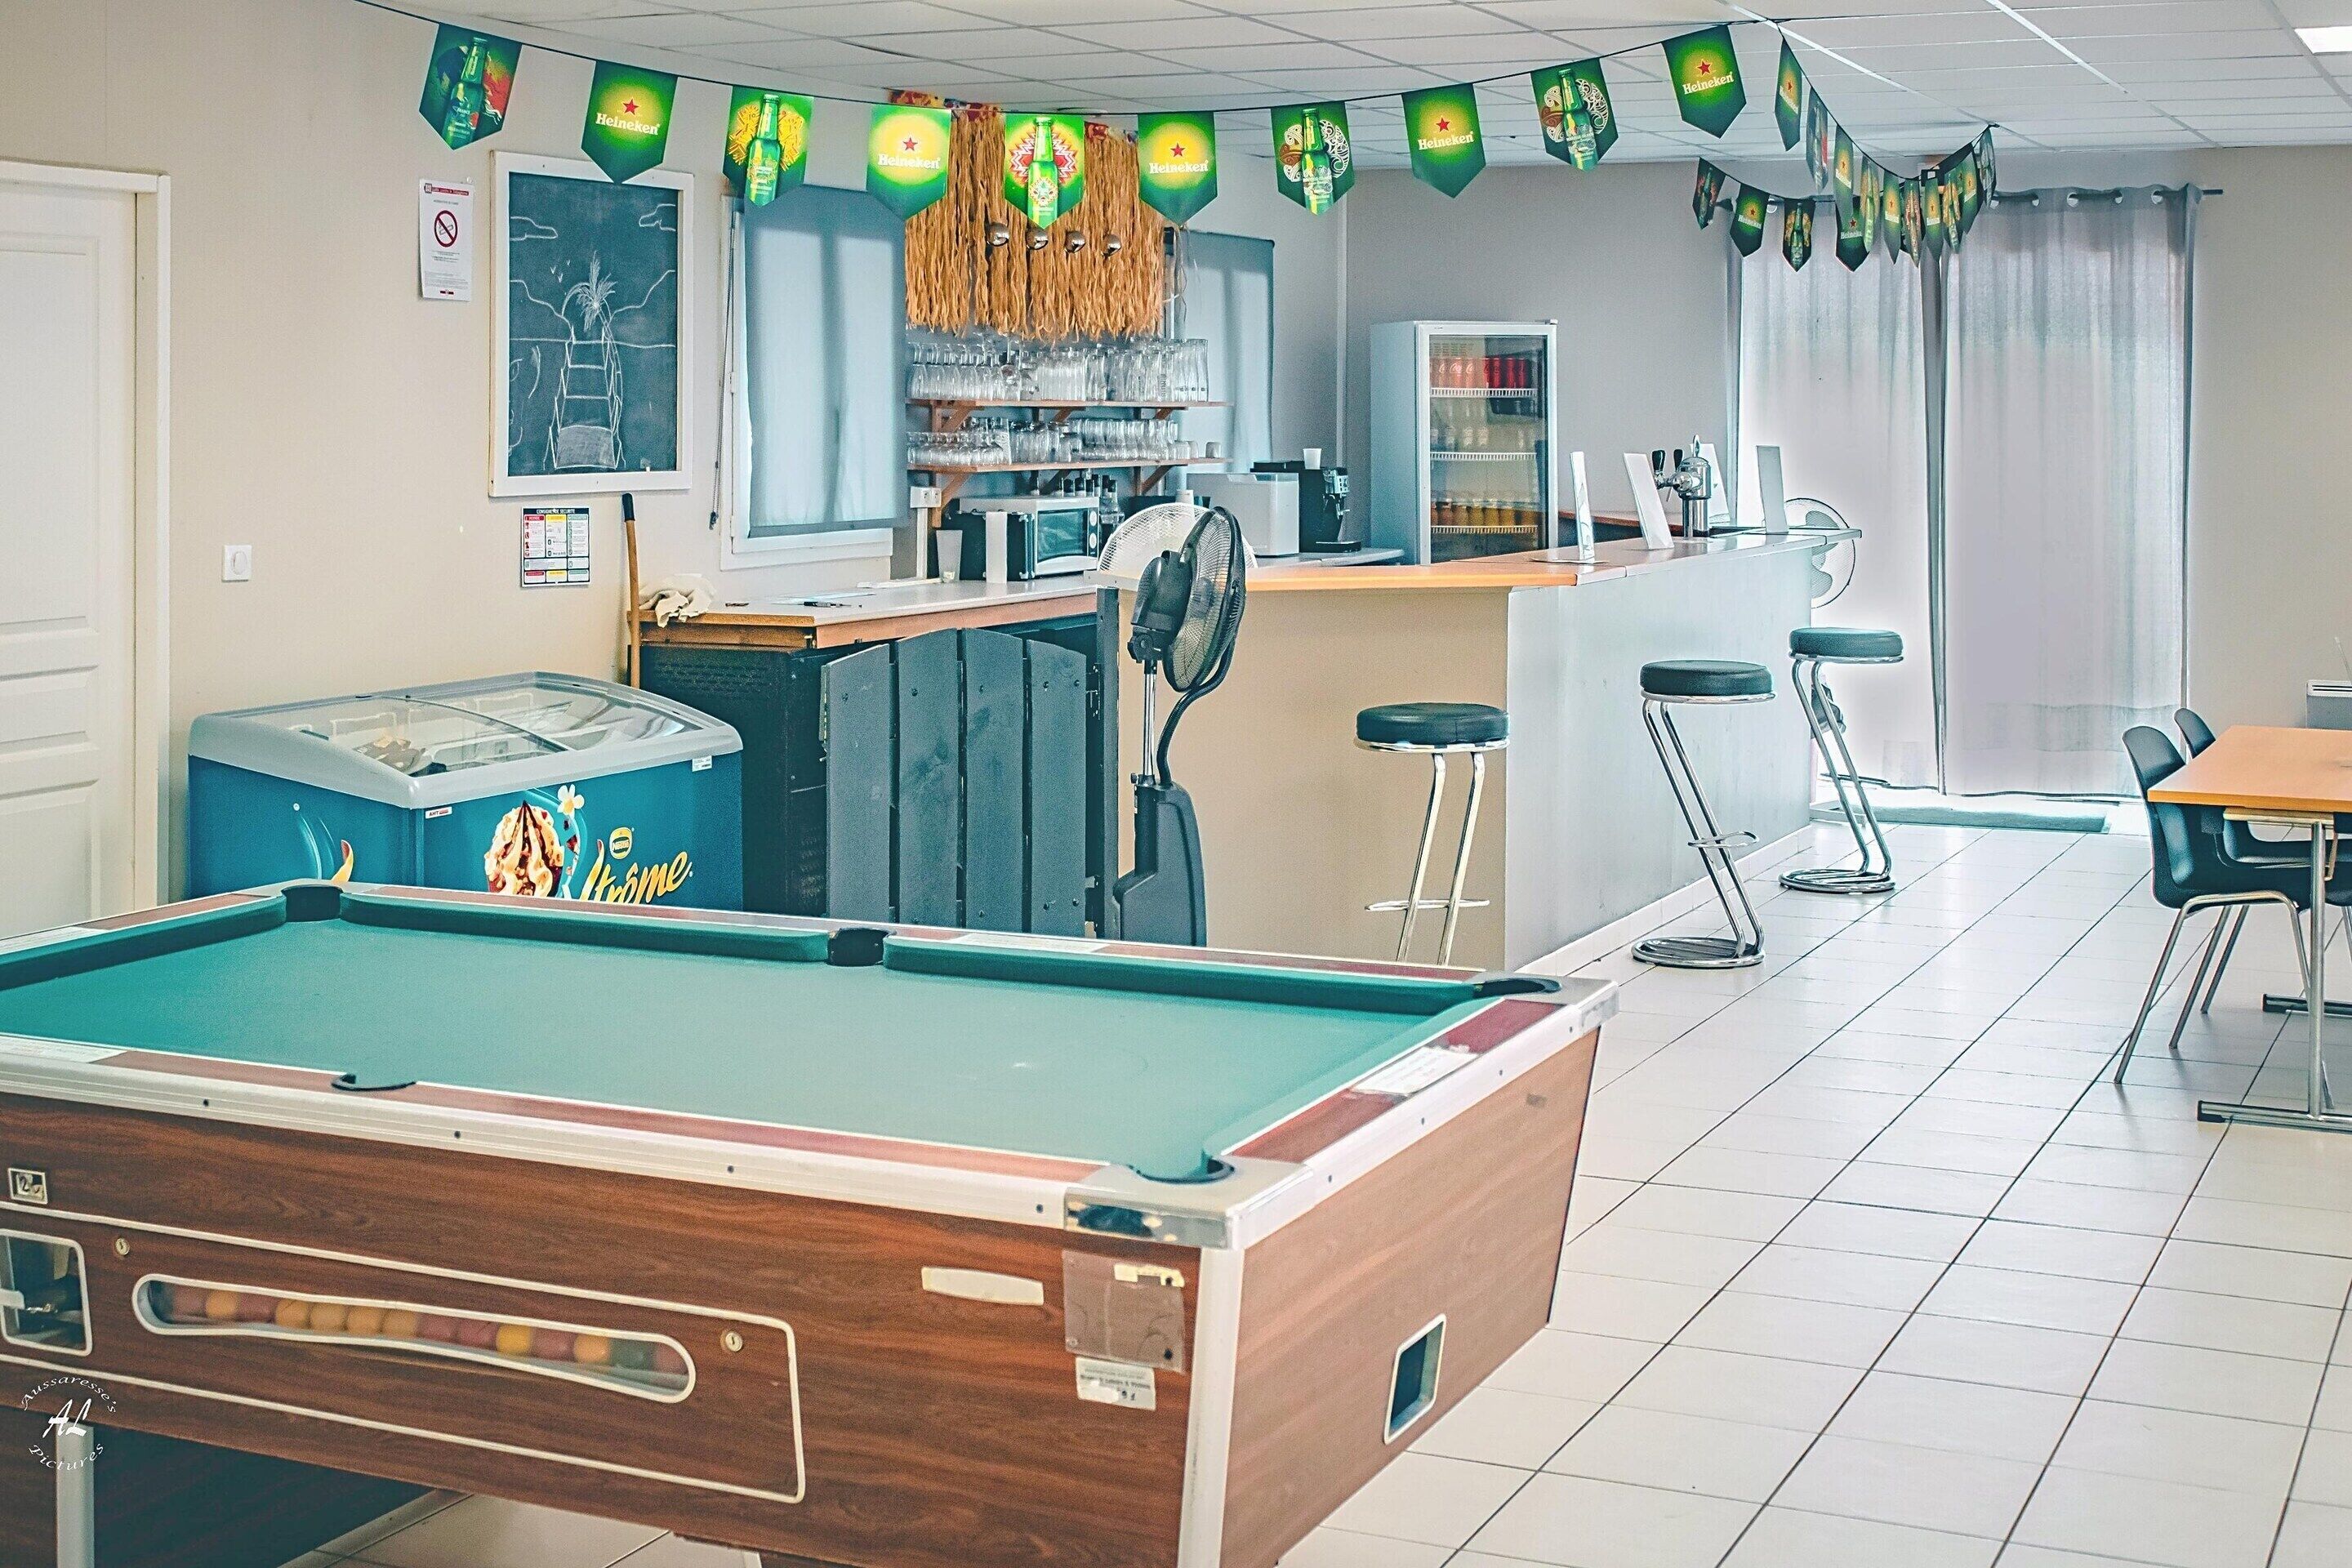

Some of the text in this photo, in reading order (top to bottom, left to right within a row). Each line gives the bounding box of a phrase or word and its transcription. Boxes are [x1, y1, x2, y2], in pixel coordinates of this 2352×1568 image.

[1682, 72, 1734, 95] Heineken
[595, 113, 660, 136] Heineken
[1418, 131, 1474, 150] Heineken
[878, 154, 940, 170] Heineken
[1149, 160, 1209, 174] Heineken
